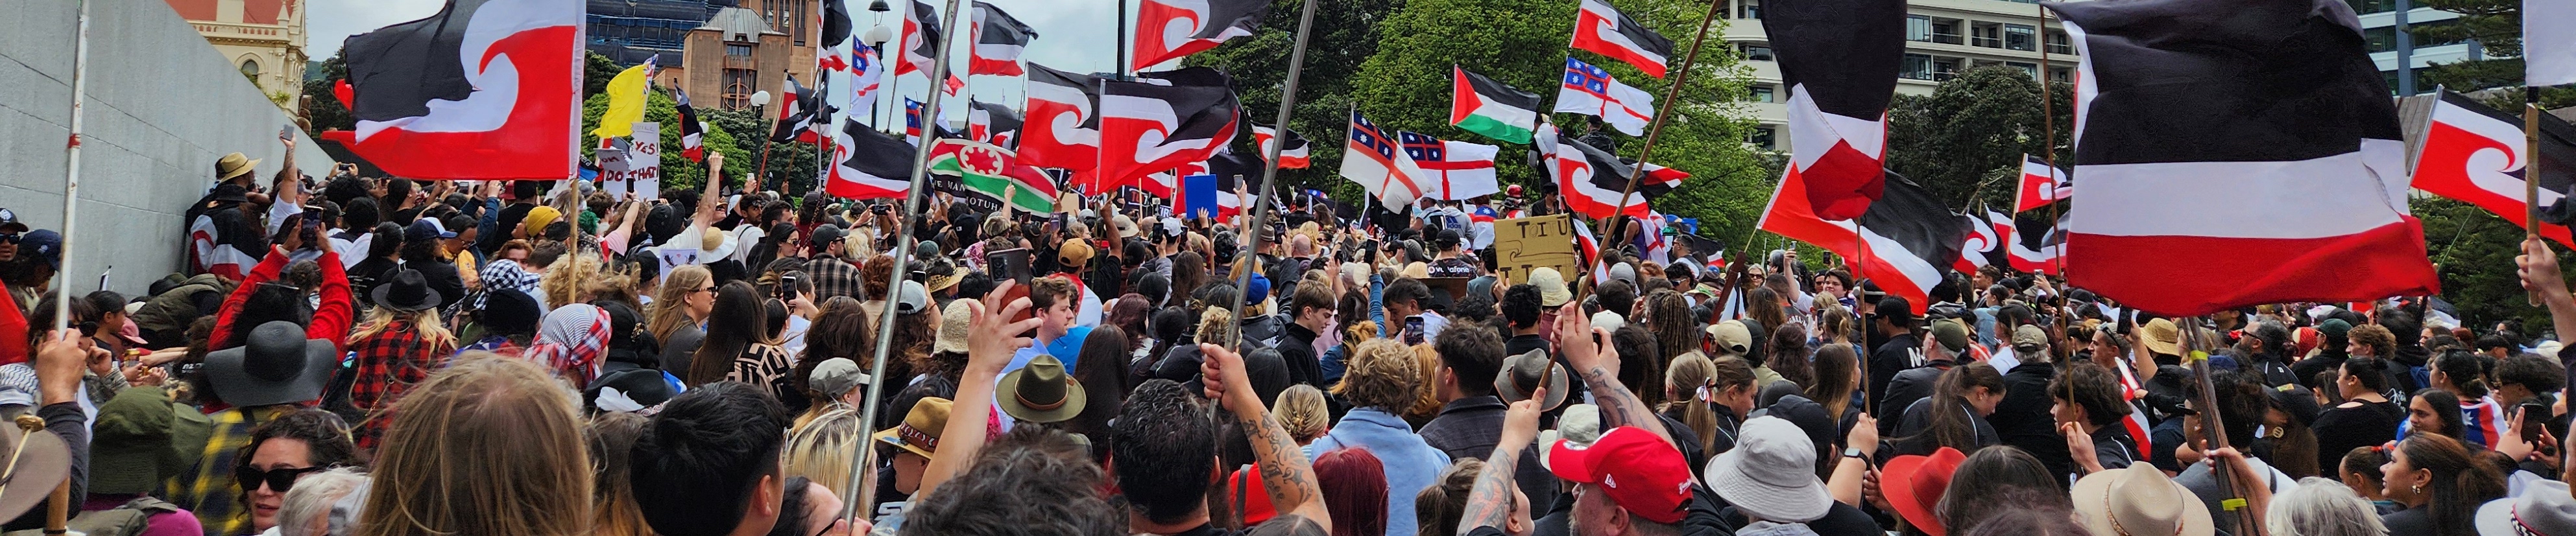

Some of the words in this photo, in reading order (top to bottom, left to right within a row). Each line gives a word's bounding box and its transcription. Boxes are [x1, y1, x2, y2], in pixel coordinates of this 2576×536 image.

[635, 141, 659, 156] YES!
[606, 170, 624, 181] DO
[628, 164, 660, 182] THAT!
[1517, 216, 1568, 239] TOITŪ
